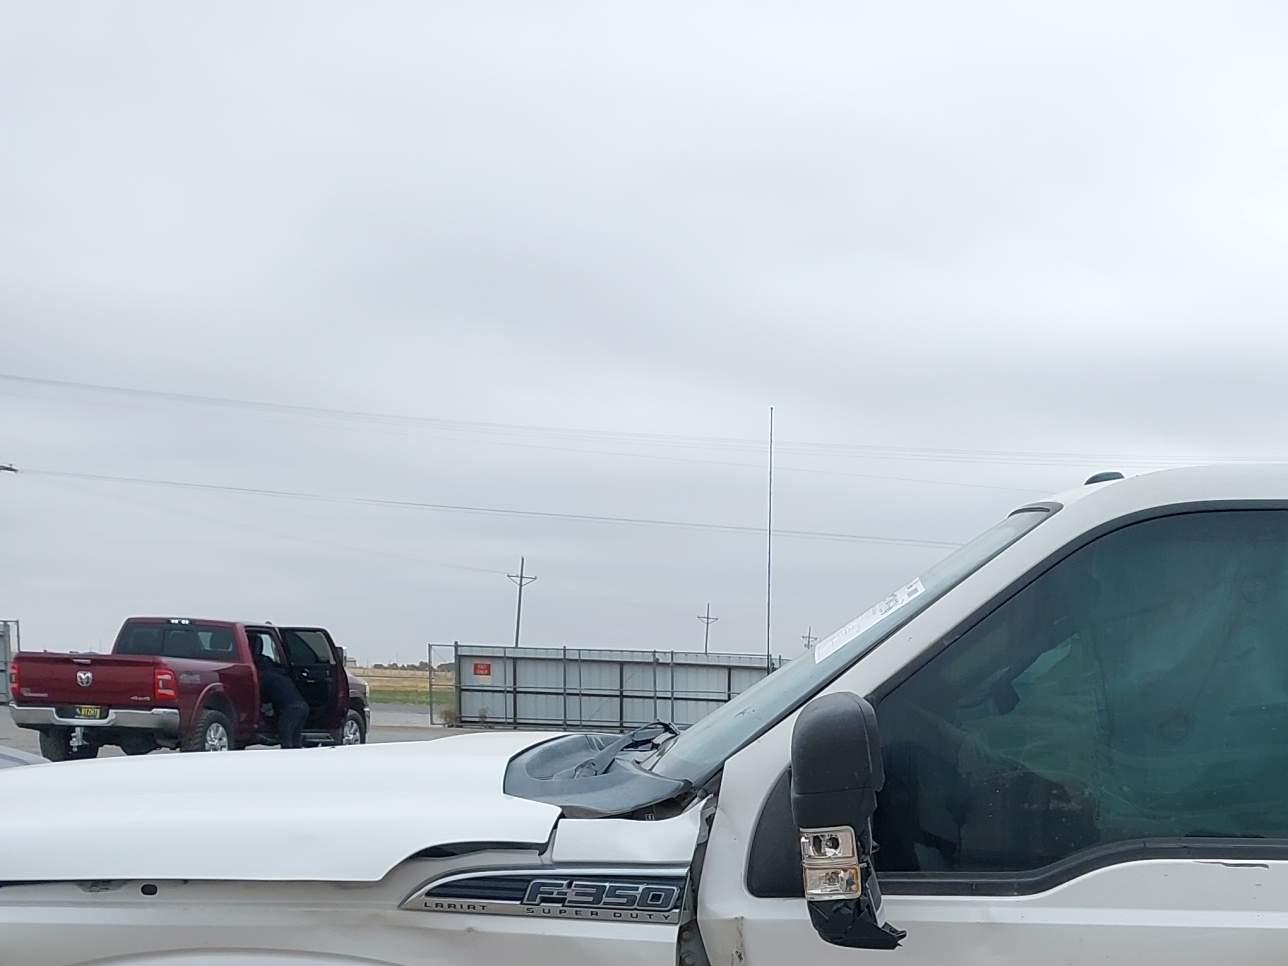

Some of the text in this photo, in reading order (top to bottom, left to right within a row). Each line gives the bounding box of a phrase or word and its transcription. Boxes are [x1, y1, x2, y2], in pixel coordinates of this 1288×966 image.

[423, 901, 489, 912] LARIAT
[525, 907, 672, 921] SUPER DUTY
